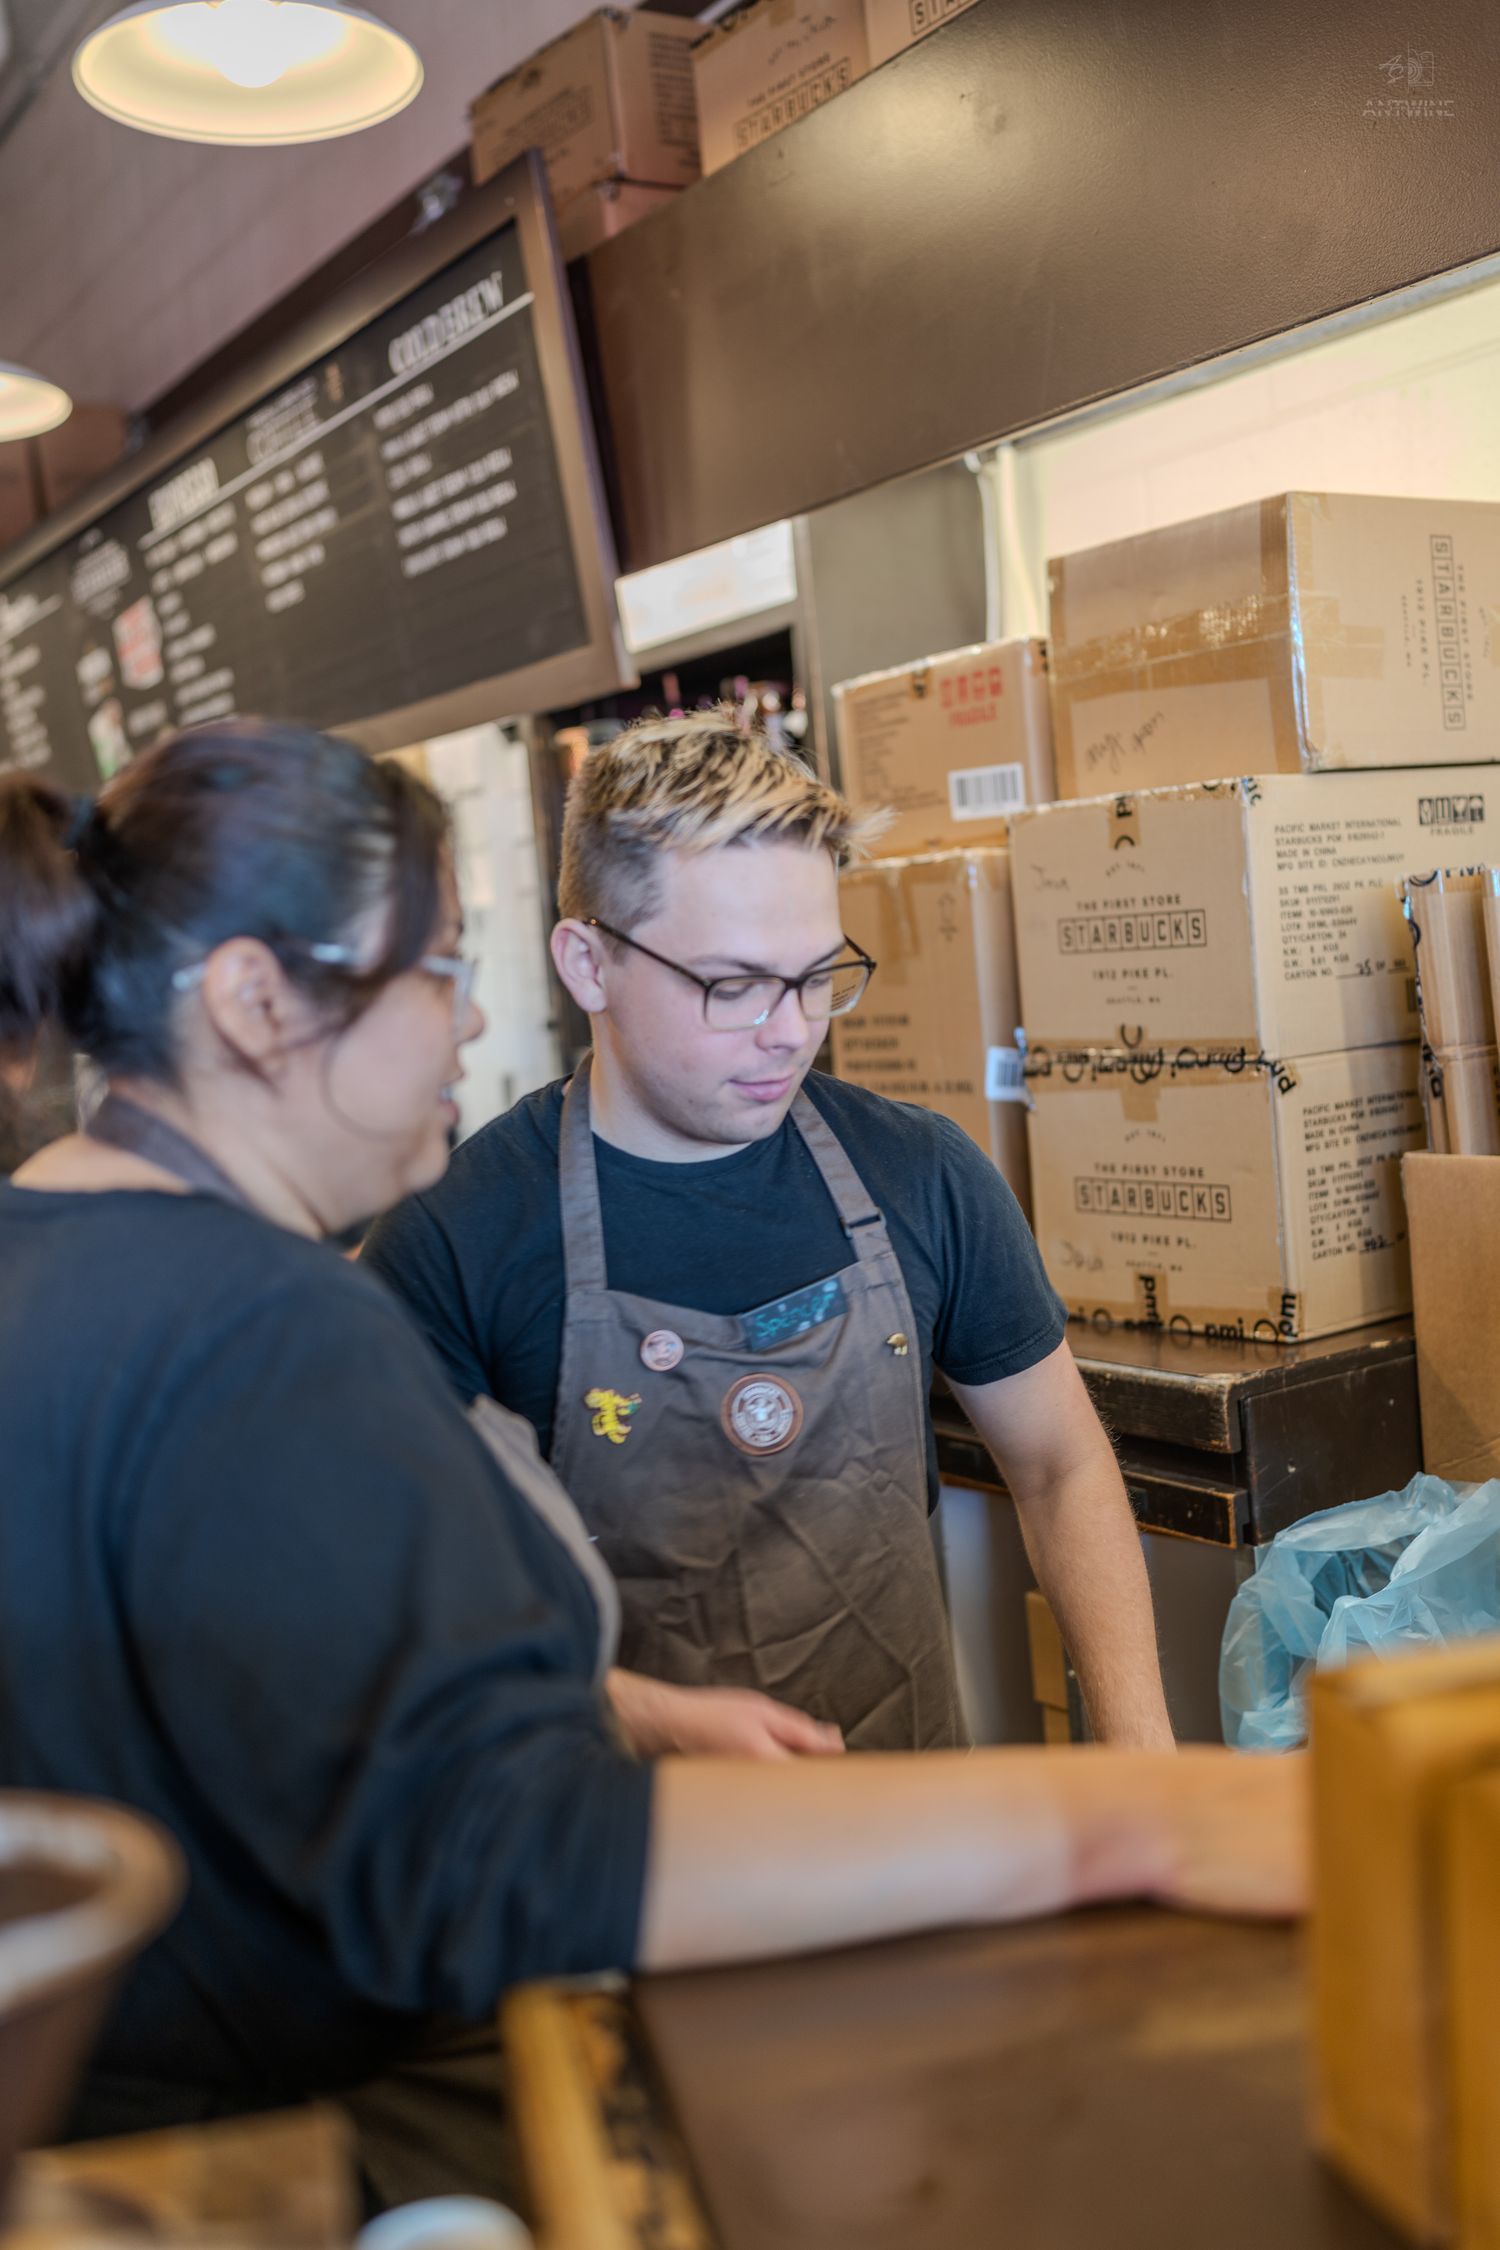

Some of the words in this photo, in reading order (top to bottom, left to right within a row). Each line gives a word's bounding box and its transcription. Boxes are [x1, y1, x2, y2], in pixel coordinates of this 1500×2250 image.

[735, 65, 849, 148] STARBUCKS
[1434, 541, 1462, 724] STARBUCKS
[1274, 823, 1305, 834] PACIFIC
[1275, 835, 1322, 847] STARBUCKS
[1076, 901, 1097, 912] THE
[1103, 897, 1136, 909] FIRST
[1142, 893, 1181, 907] STORE
[1062, 915, 1203, 950] STARBUCKS
[1122, 967, 1148, 979] PIKE
[1094, 1162, 1117, 1175] THE
[1122, 1163, 1157, 1176] FIRST
[1163, 1165, 1205, 1179] STORE
[1078, 1183, 1227, 1216] STARBUCKS
[1142, 1233, 1171, 1247] PIKE
